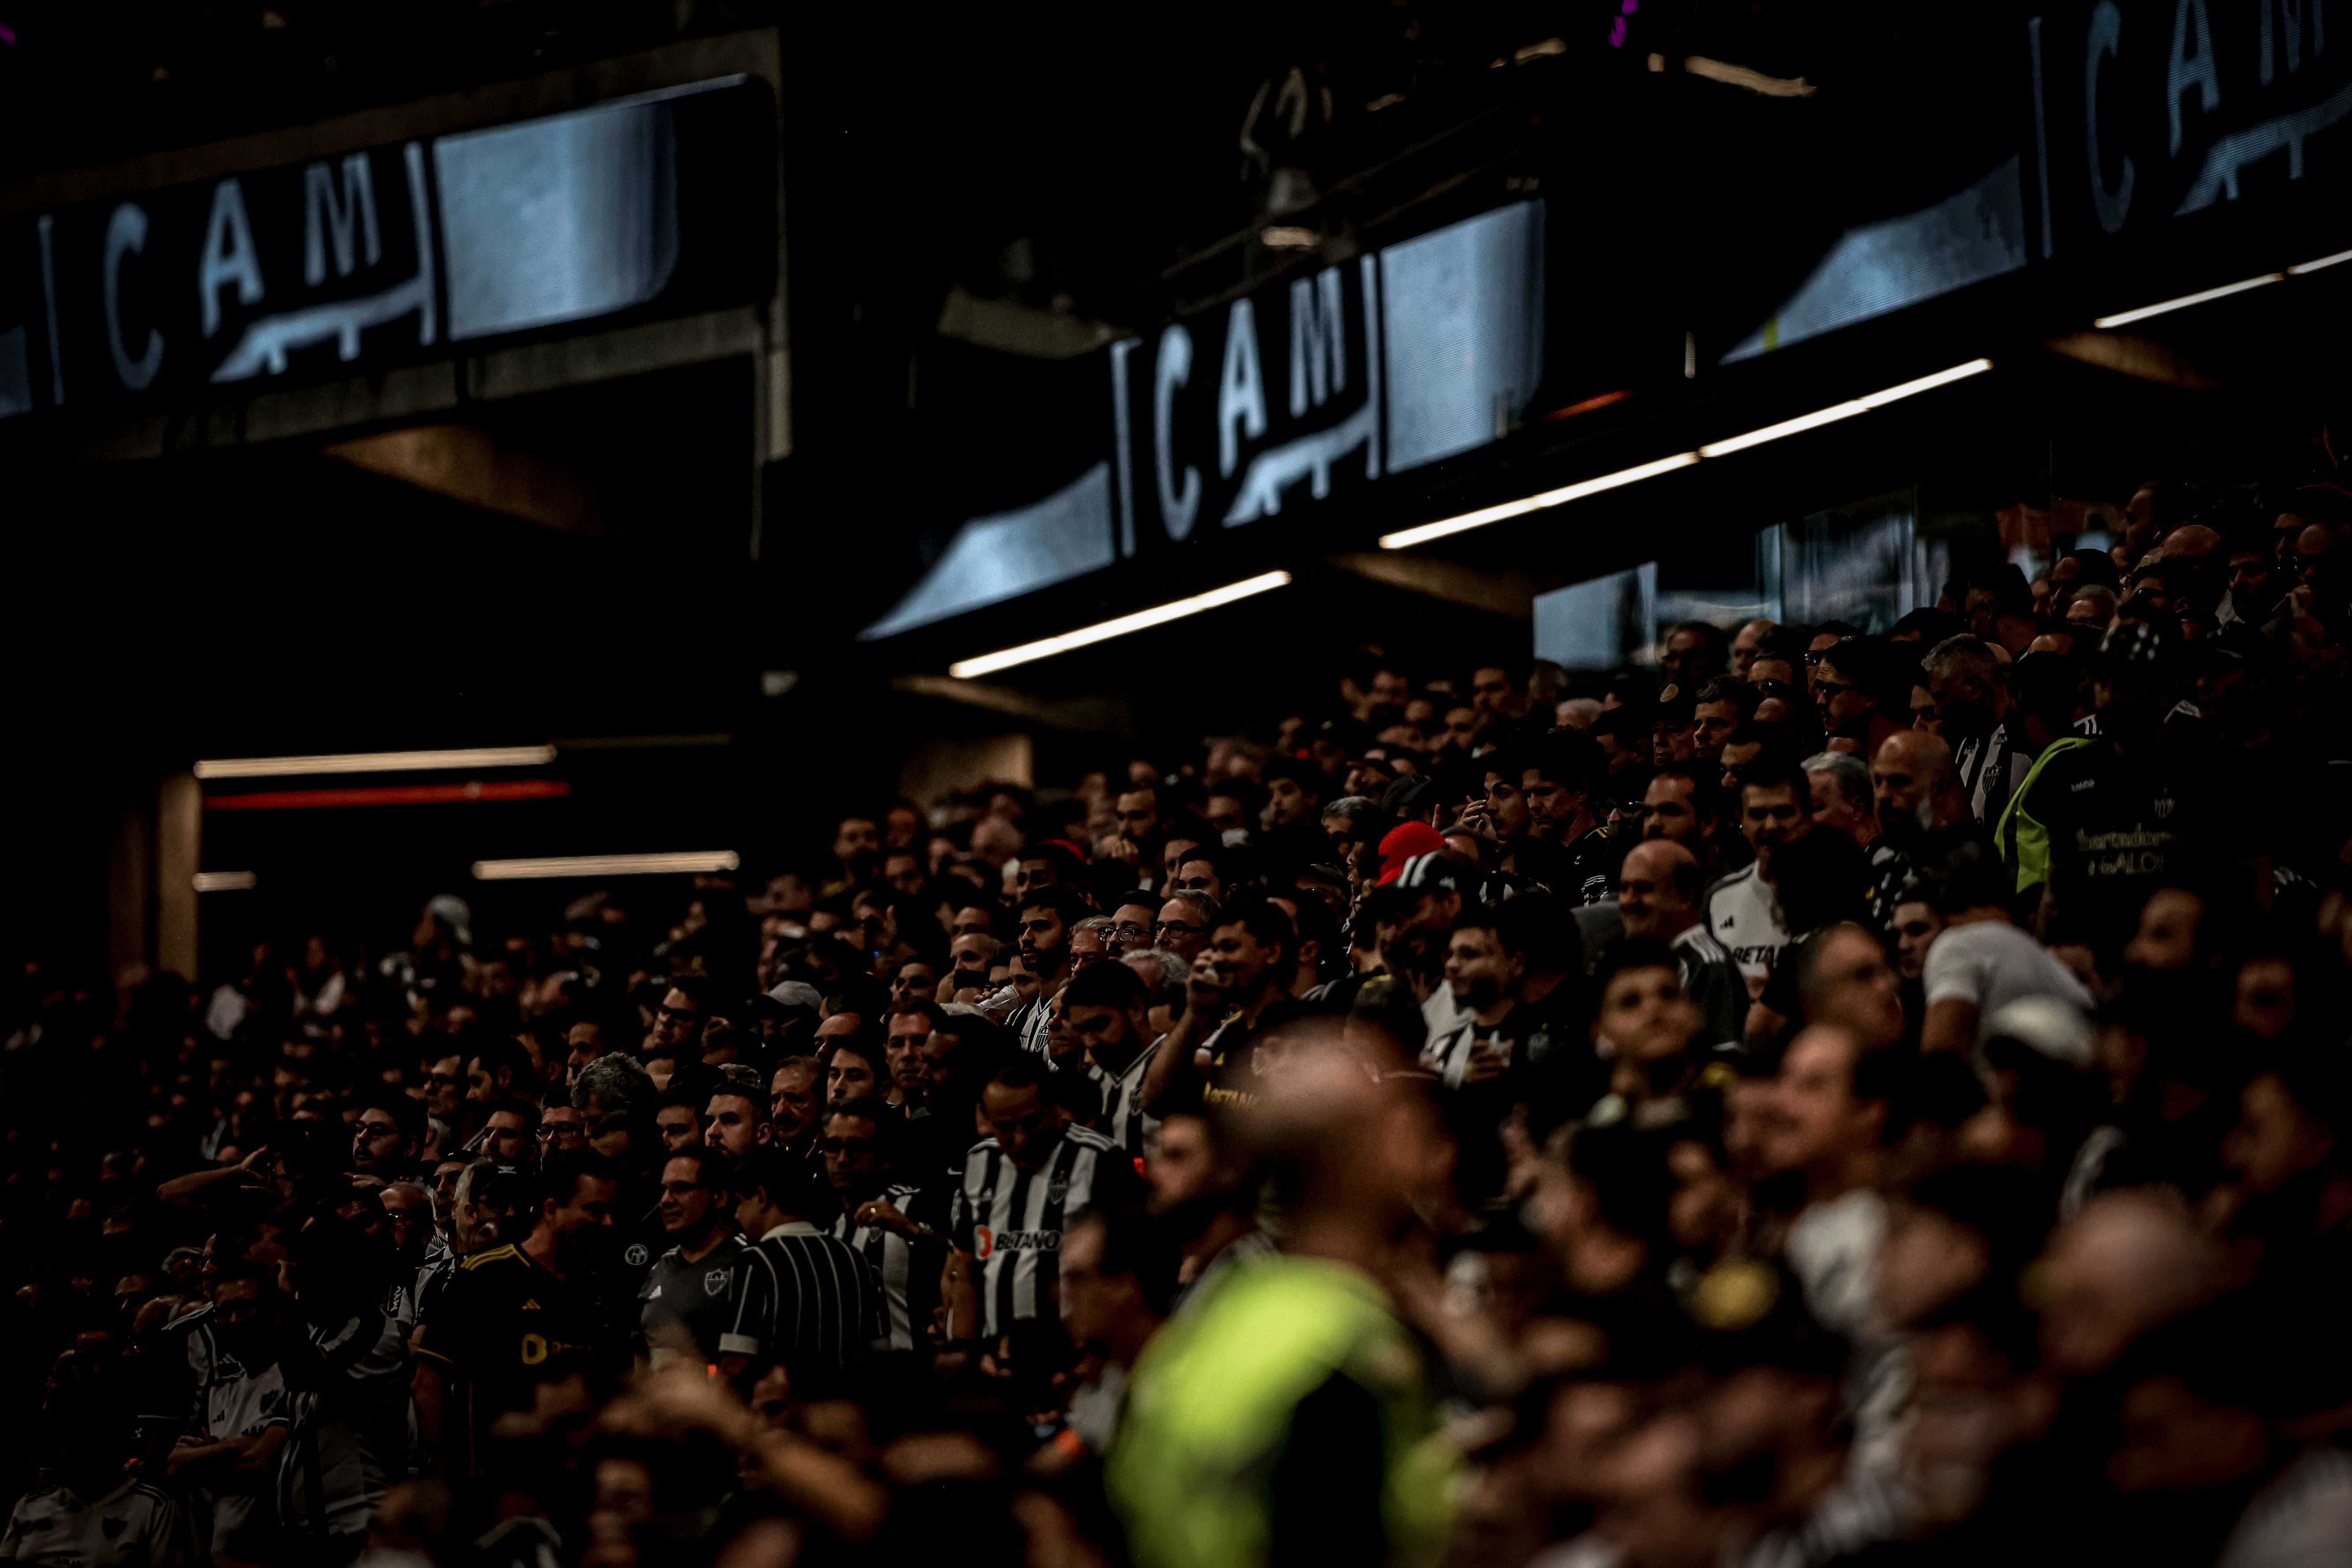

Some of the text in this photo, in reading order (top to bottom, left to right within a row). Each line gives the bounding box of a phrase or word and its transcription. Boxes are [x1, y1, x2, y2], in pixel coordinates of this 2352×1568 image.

[102, 151, 383, 392] CAM
[1153, 265, 1346, 543] CAM
[996, 1233, 1059, 1249] BETANO
